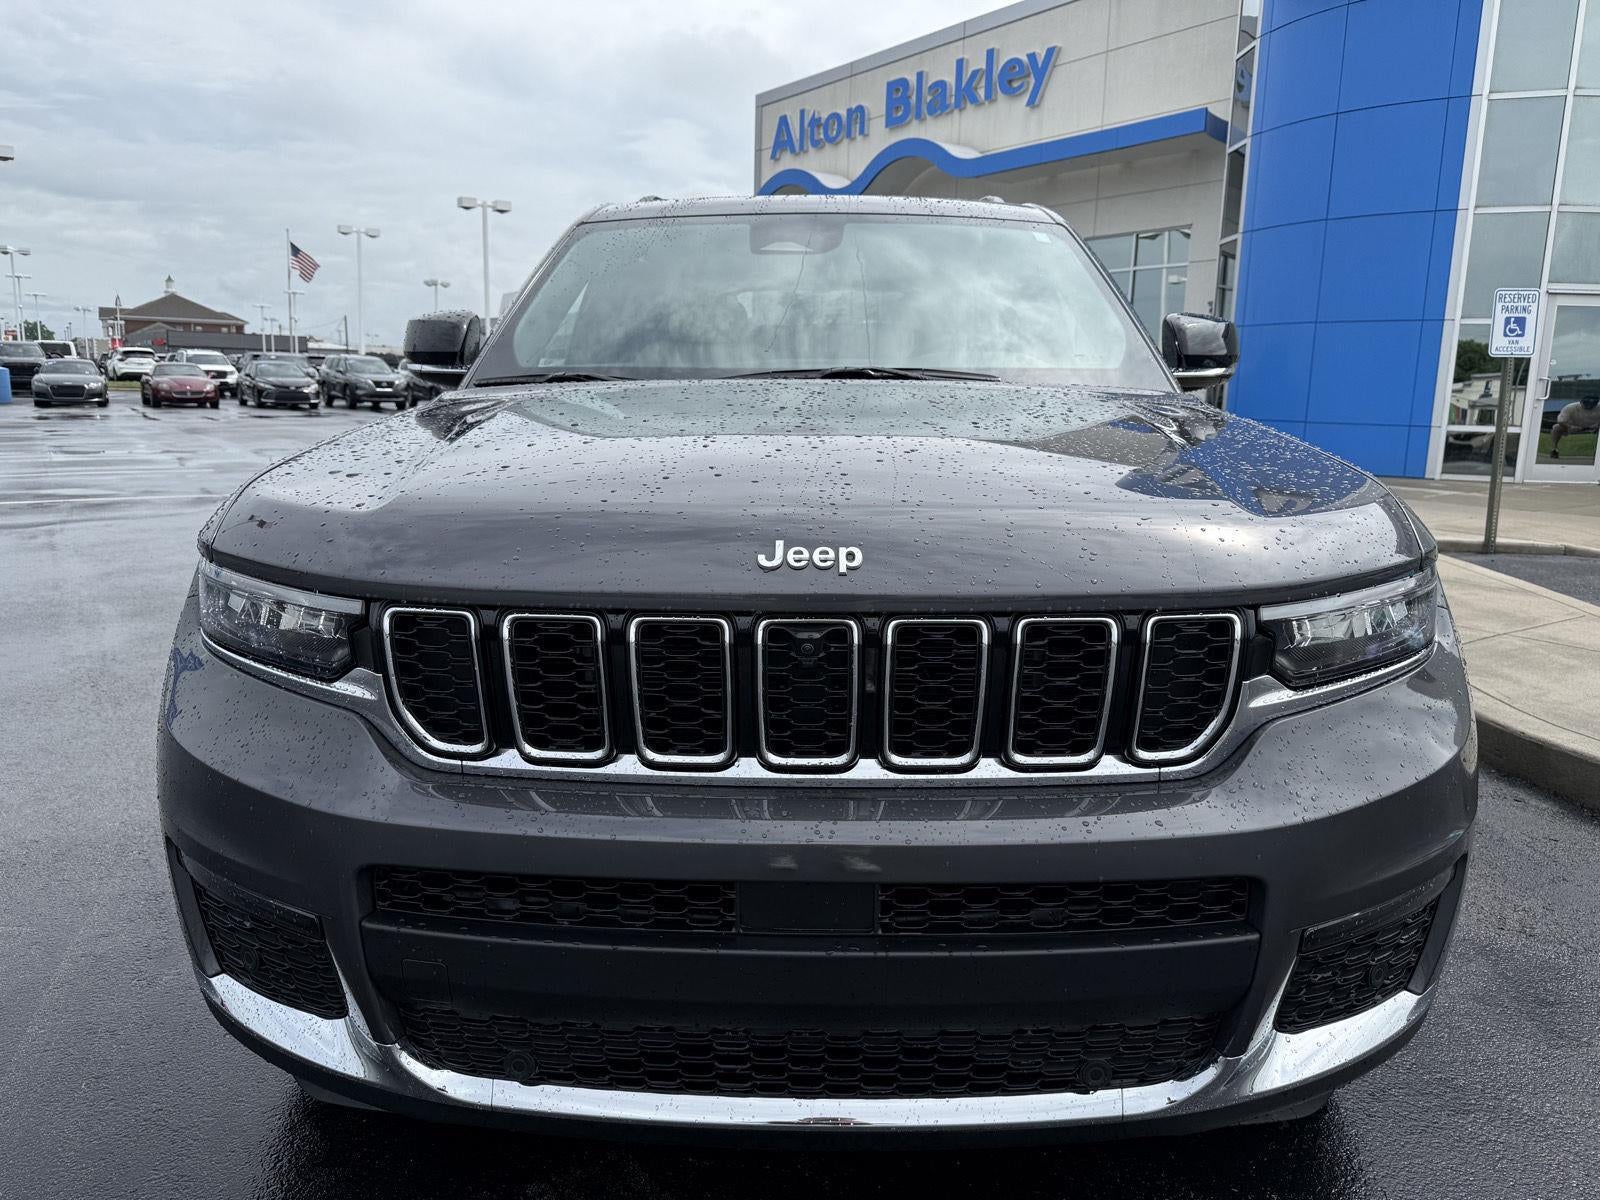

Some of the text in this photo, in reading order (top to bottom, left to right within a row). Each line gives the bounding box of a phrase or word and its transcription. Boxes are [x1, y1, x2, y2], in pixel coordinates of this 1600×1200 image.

[770, 45, 1061, 161] Alton Blakley
[1498, 293, 1536, 303] RESERVED
[1501, 305, 1532, 314] PARKING
[757, 540, 863, 576] Jeep
